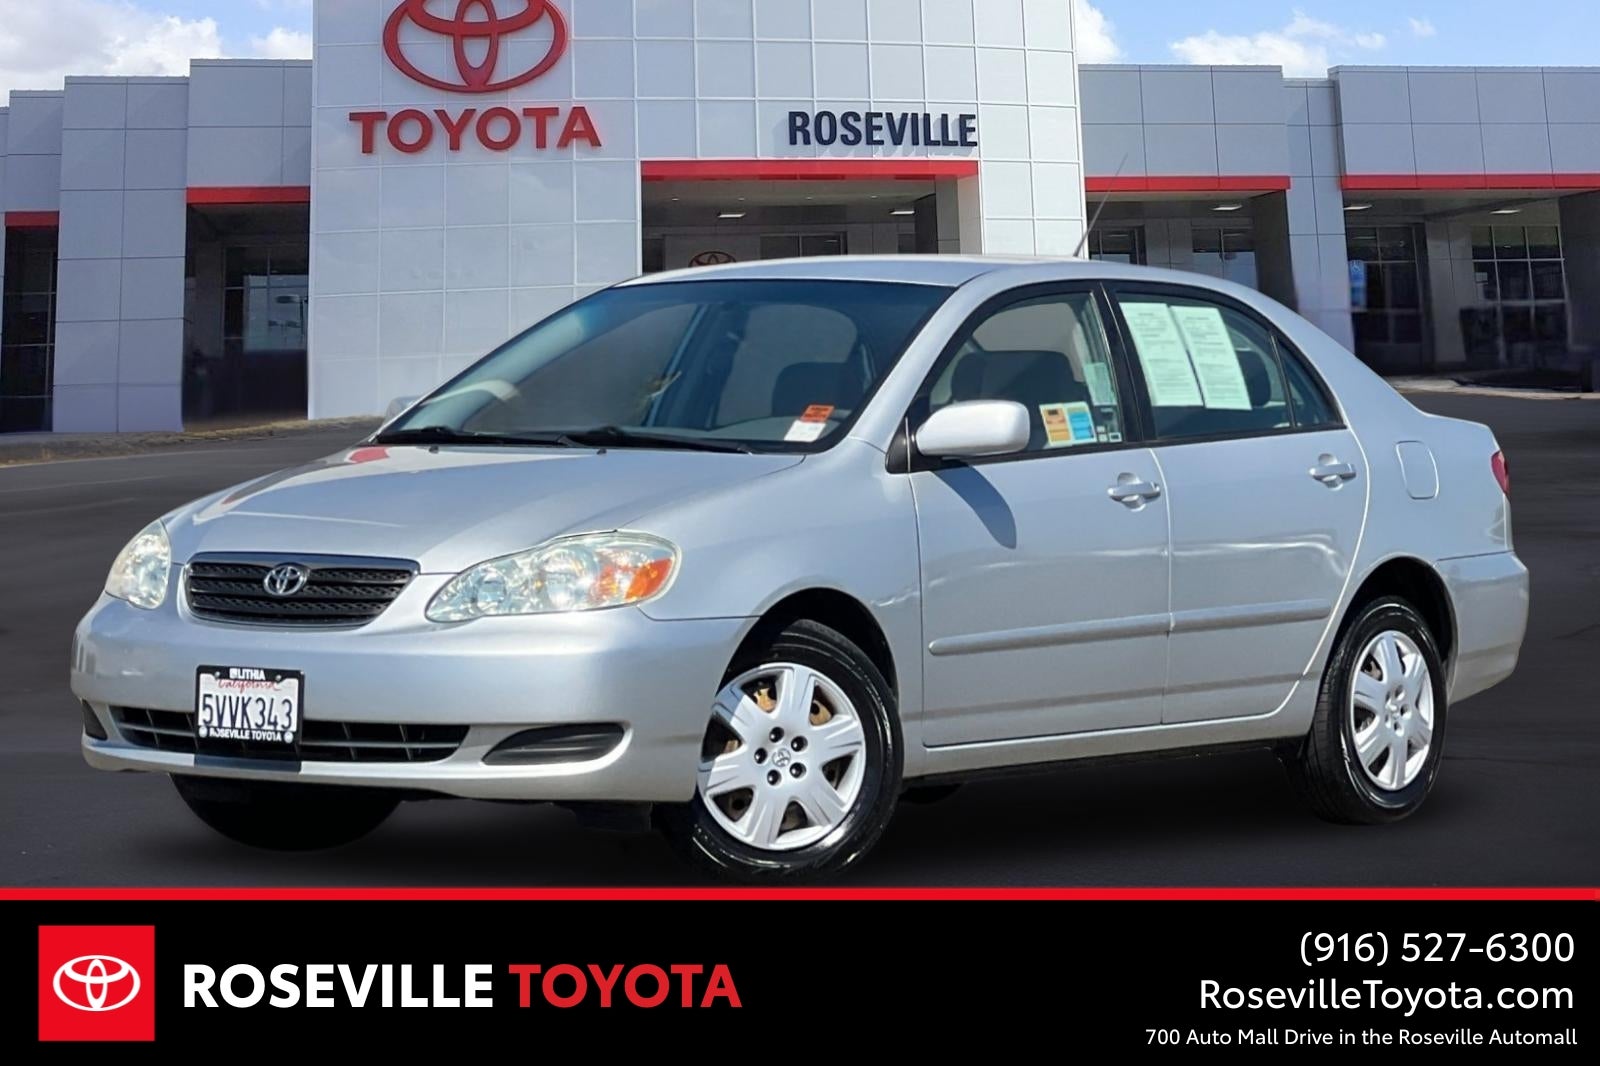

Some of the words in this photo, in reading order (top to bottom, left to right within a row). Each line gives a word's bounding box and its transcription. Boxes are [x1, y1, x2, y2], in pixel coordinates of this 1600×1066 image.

[349, 106, 602, 154] TOYOTA
[788, 110, 978, 148] ROSEVILLE
[239, 668, 266, 681] LITHIA
[202, 693, 293, 730] 5VVK343
[209, 727, 250, 740] ROSEVILLE
[251, 730, 282, 742] TOYOTA
